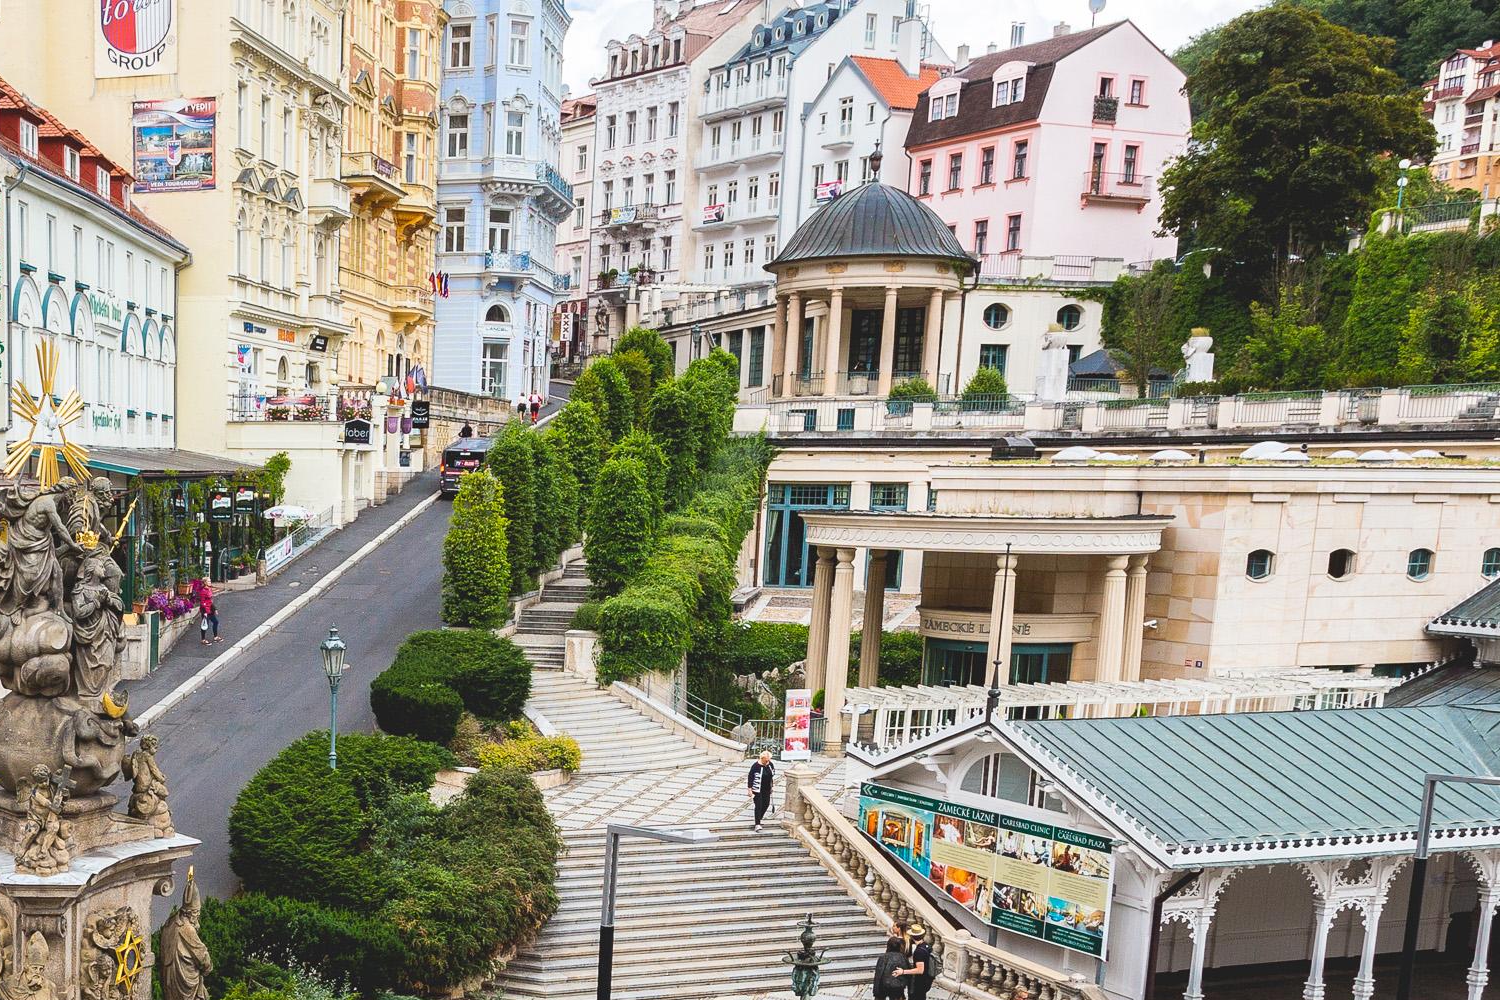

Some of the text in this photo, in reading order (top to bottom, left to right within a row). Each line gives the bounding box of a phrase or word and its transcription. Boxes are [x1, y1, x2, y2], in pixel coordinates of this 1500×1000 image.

[107, 43, 166, 71] GROUP
[562, 313, 571, 340] XXXL
[344, 426, 370, 439] faber
[924, 618, 1031, 636] ZÁMECKÉ LNĚ
[938, 802, 995, 824] ZÁMECKÉ LÁZNĚ
[1002, 817, 1051, 835] CARLSBAD CLINIC
[1057, 832, 1106, 849] CARLSBAD PLAZA
